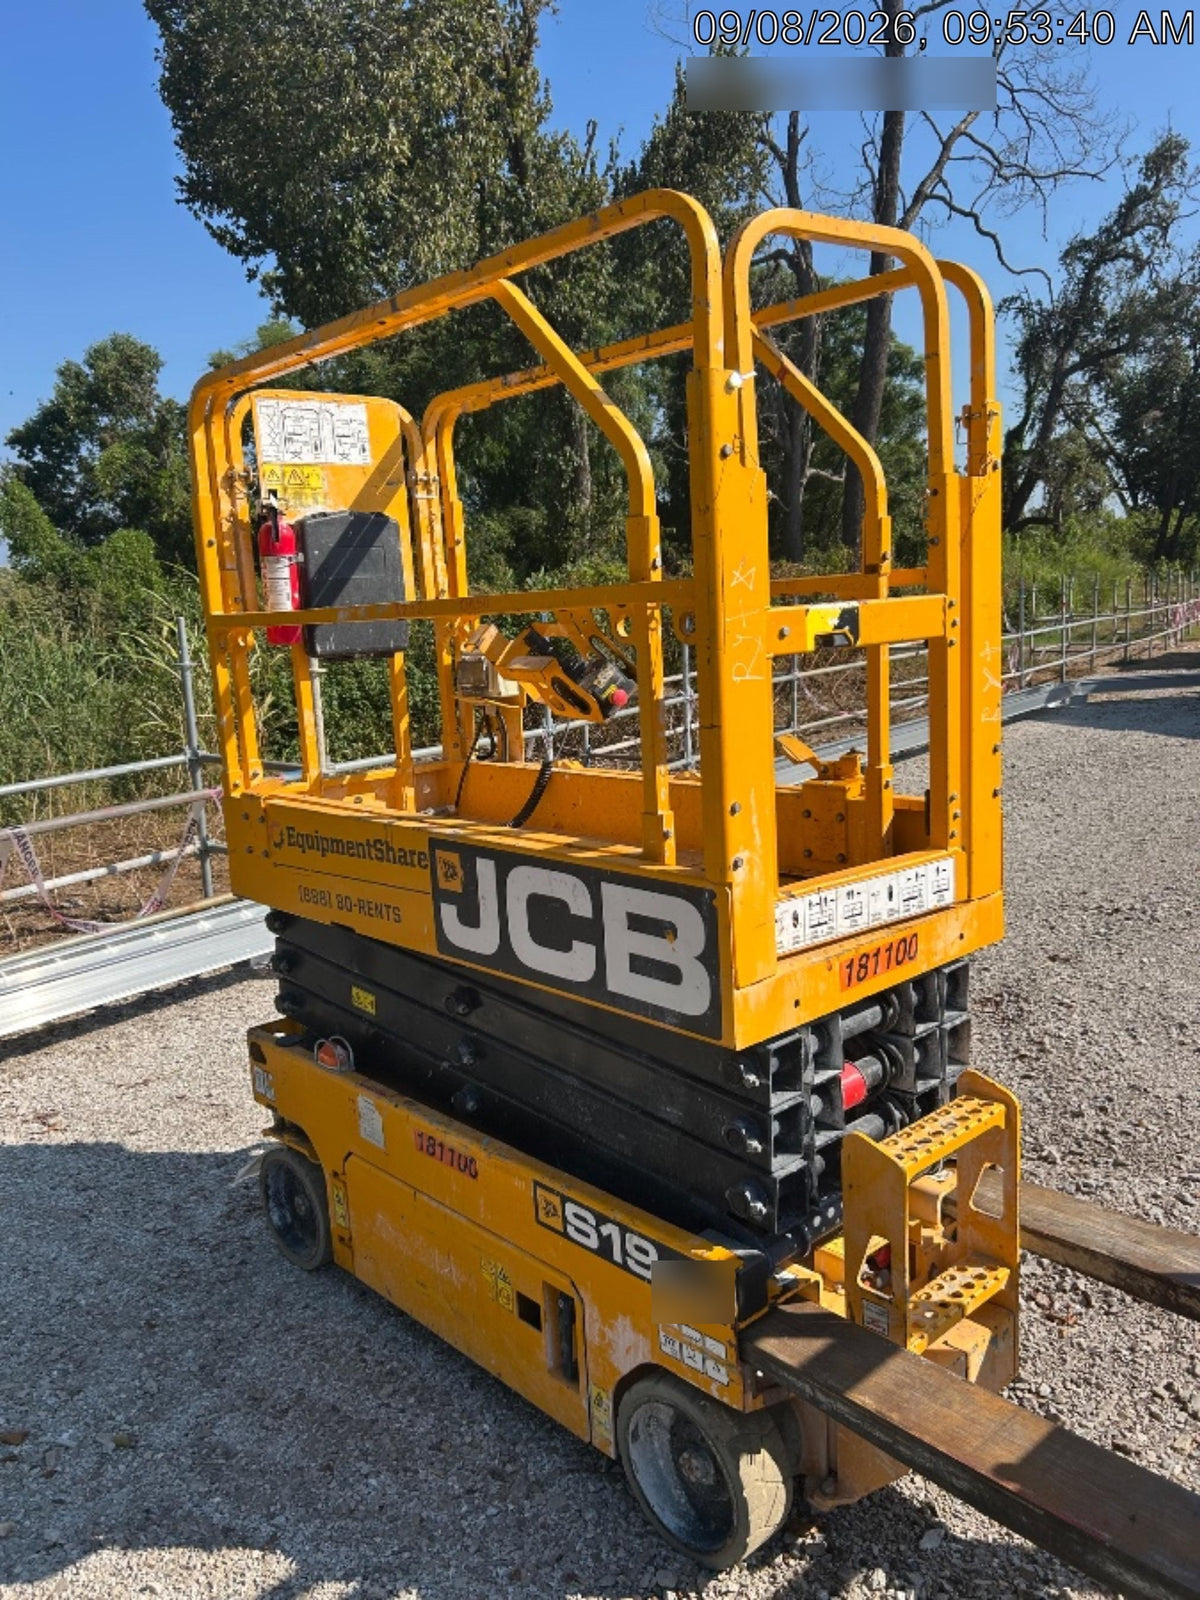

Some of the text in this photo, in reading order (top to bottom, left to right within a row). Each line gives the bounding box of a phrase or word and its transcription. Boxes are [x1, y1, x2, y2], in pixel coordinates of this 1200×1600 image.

[286, 826, 429, 869] EquipmentShare
[439, 856, 711, 1017] JCB
[845, 933, 919, 988] 181100
[417, 1131, 479, 1179] 181100
[565, 1201, 659, 1280] S19
